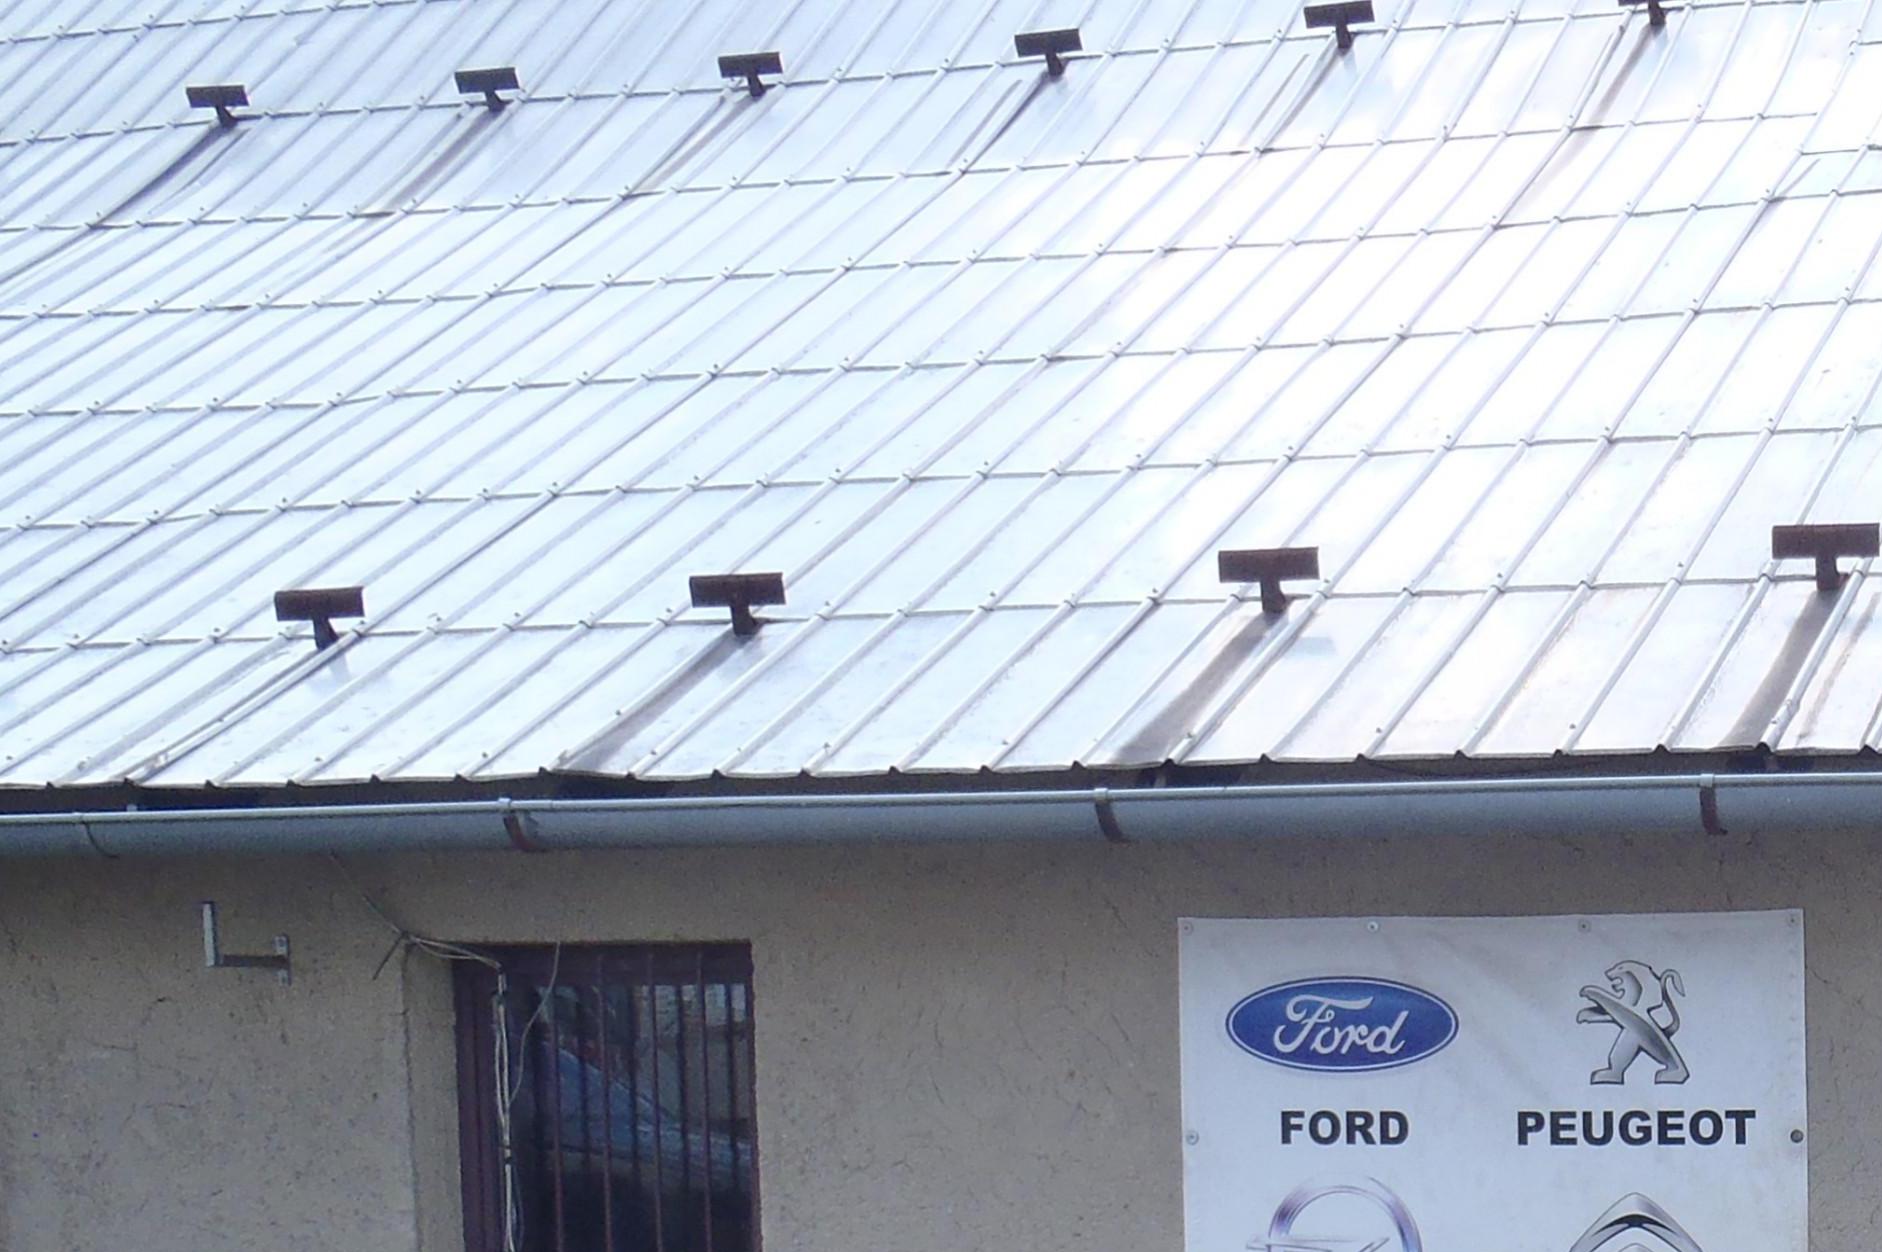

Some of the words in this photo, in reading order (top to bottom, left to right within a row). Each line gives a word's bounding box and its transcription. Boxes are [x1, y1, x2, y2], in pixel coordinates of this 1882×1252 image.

[1273, 993, 1407, 1056] Ford
[1280, 1109, 1410, 1146] FORD
[1516, 1108, 1757, 1147] PEUGEOT
